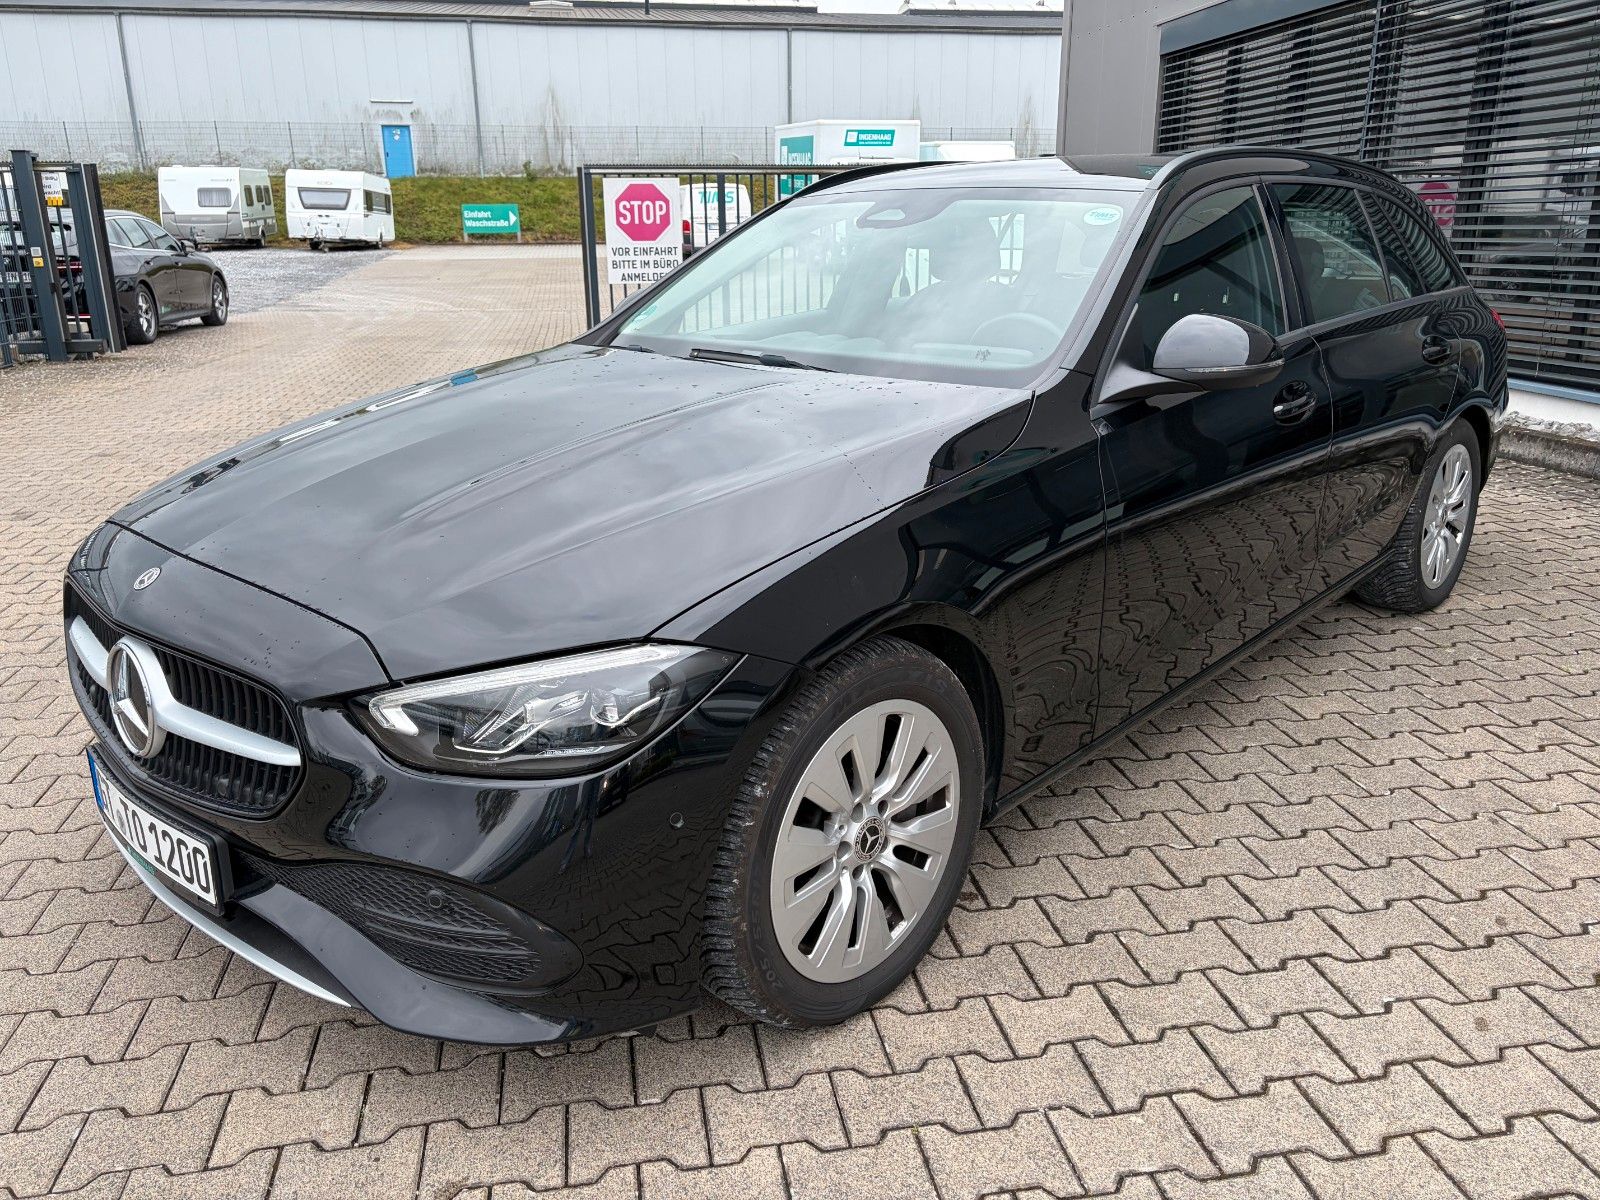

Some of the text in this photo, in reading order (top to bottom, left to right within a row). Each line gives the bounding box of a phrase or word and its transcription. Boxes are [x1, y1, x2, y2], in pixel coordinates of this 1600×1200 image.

[859, 133, 892, 141] INGENHAAG
[463, 210, 492, 218] Einfahrt
[618, 200, 667, 225] STOP
[464, 219, 509, 227] Waschstraße
[611, 246, 678, 257] VOR EINFAHRT
[611, 258, 679, 270] BITTE IM BÜRO
[620, 272, 668, 282] ANMELDE
[119, 797, 148, 853] TO
[148, 822, 211, 893] 1200
